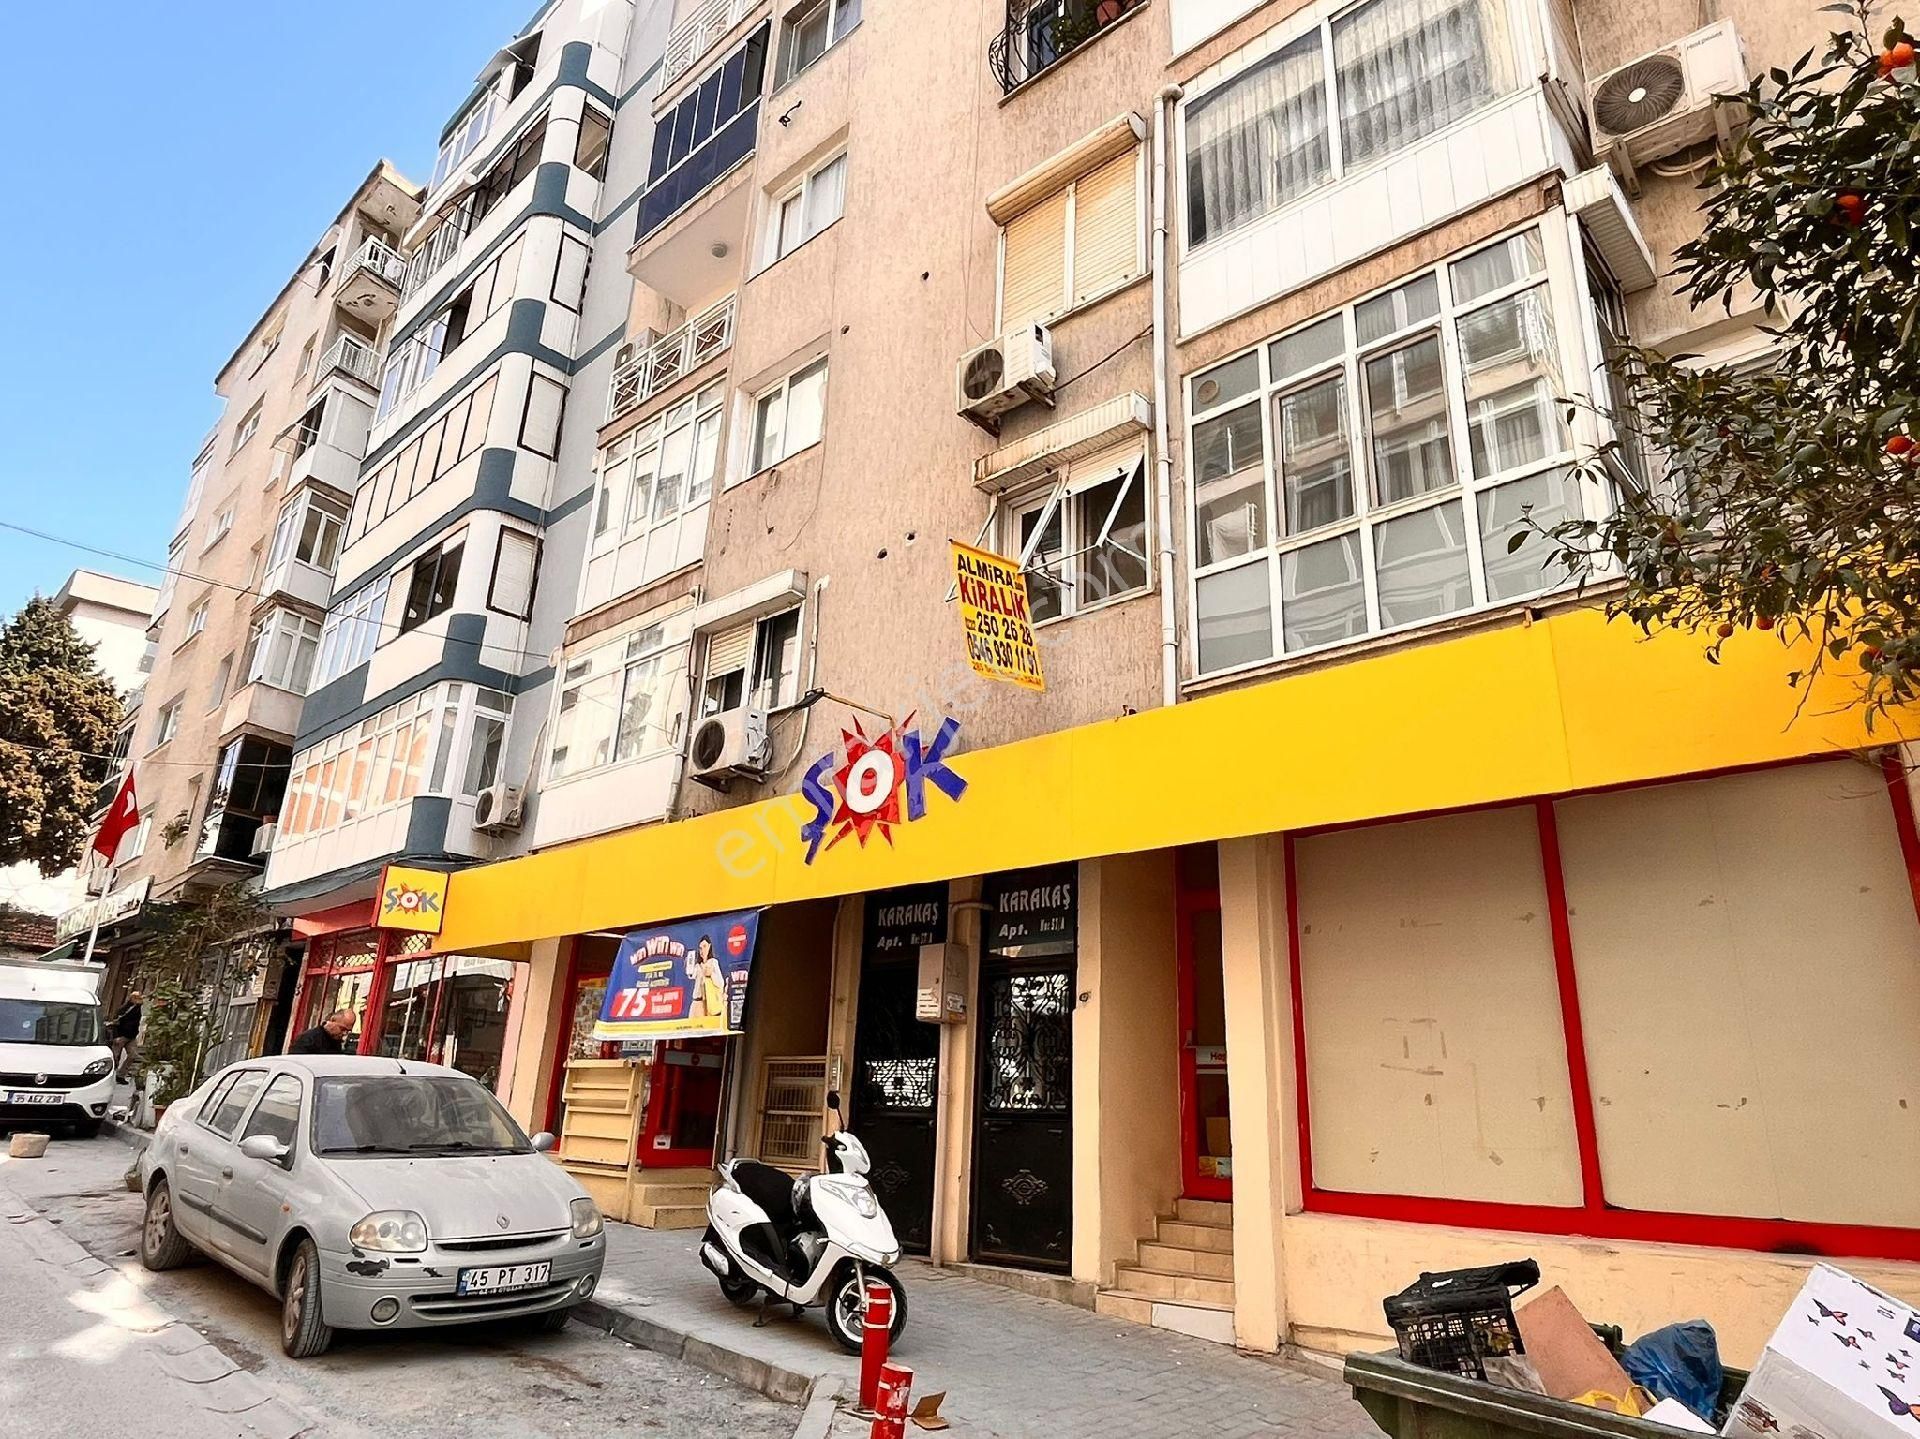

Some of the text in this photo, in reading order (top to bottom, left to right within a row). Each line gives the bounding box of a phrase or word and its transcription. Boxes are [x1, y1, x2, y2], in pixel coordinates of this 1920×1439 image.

[976, 611, 999, 637] 250
[1002, 617, 1018, 641] 26
[1020, 624, 1033, 647] 28
[967, 631, 994, 664] 0546
[993, 640, 1013, 669] 930
[801, 716, 968, 866] ŞOK
[384, 885, 440, 914] ŞOK
[999, 884, 1071, 913] KARAKAŞ
[878, 901, 938, 926] KARAKAŞ
[876, 936, 903, 951] Apt.
[998, 923, 1028, 940] Apt.
[616, 987, 650, 1017] 75
[471, 1264, 548, 1288] 45 PT 317
